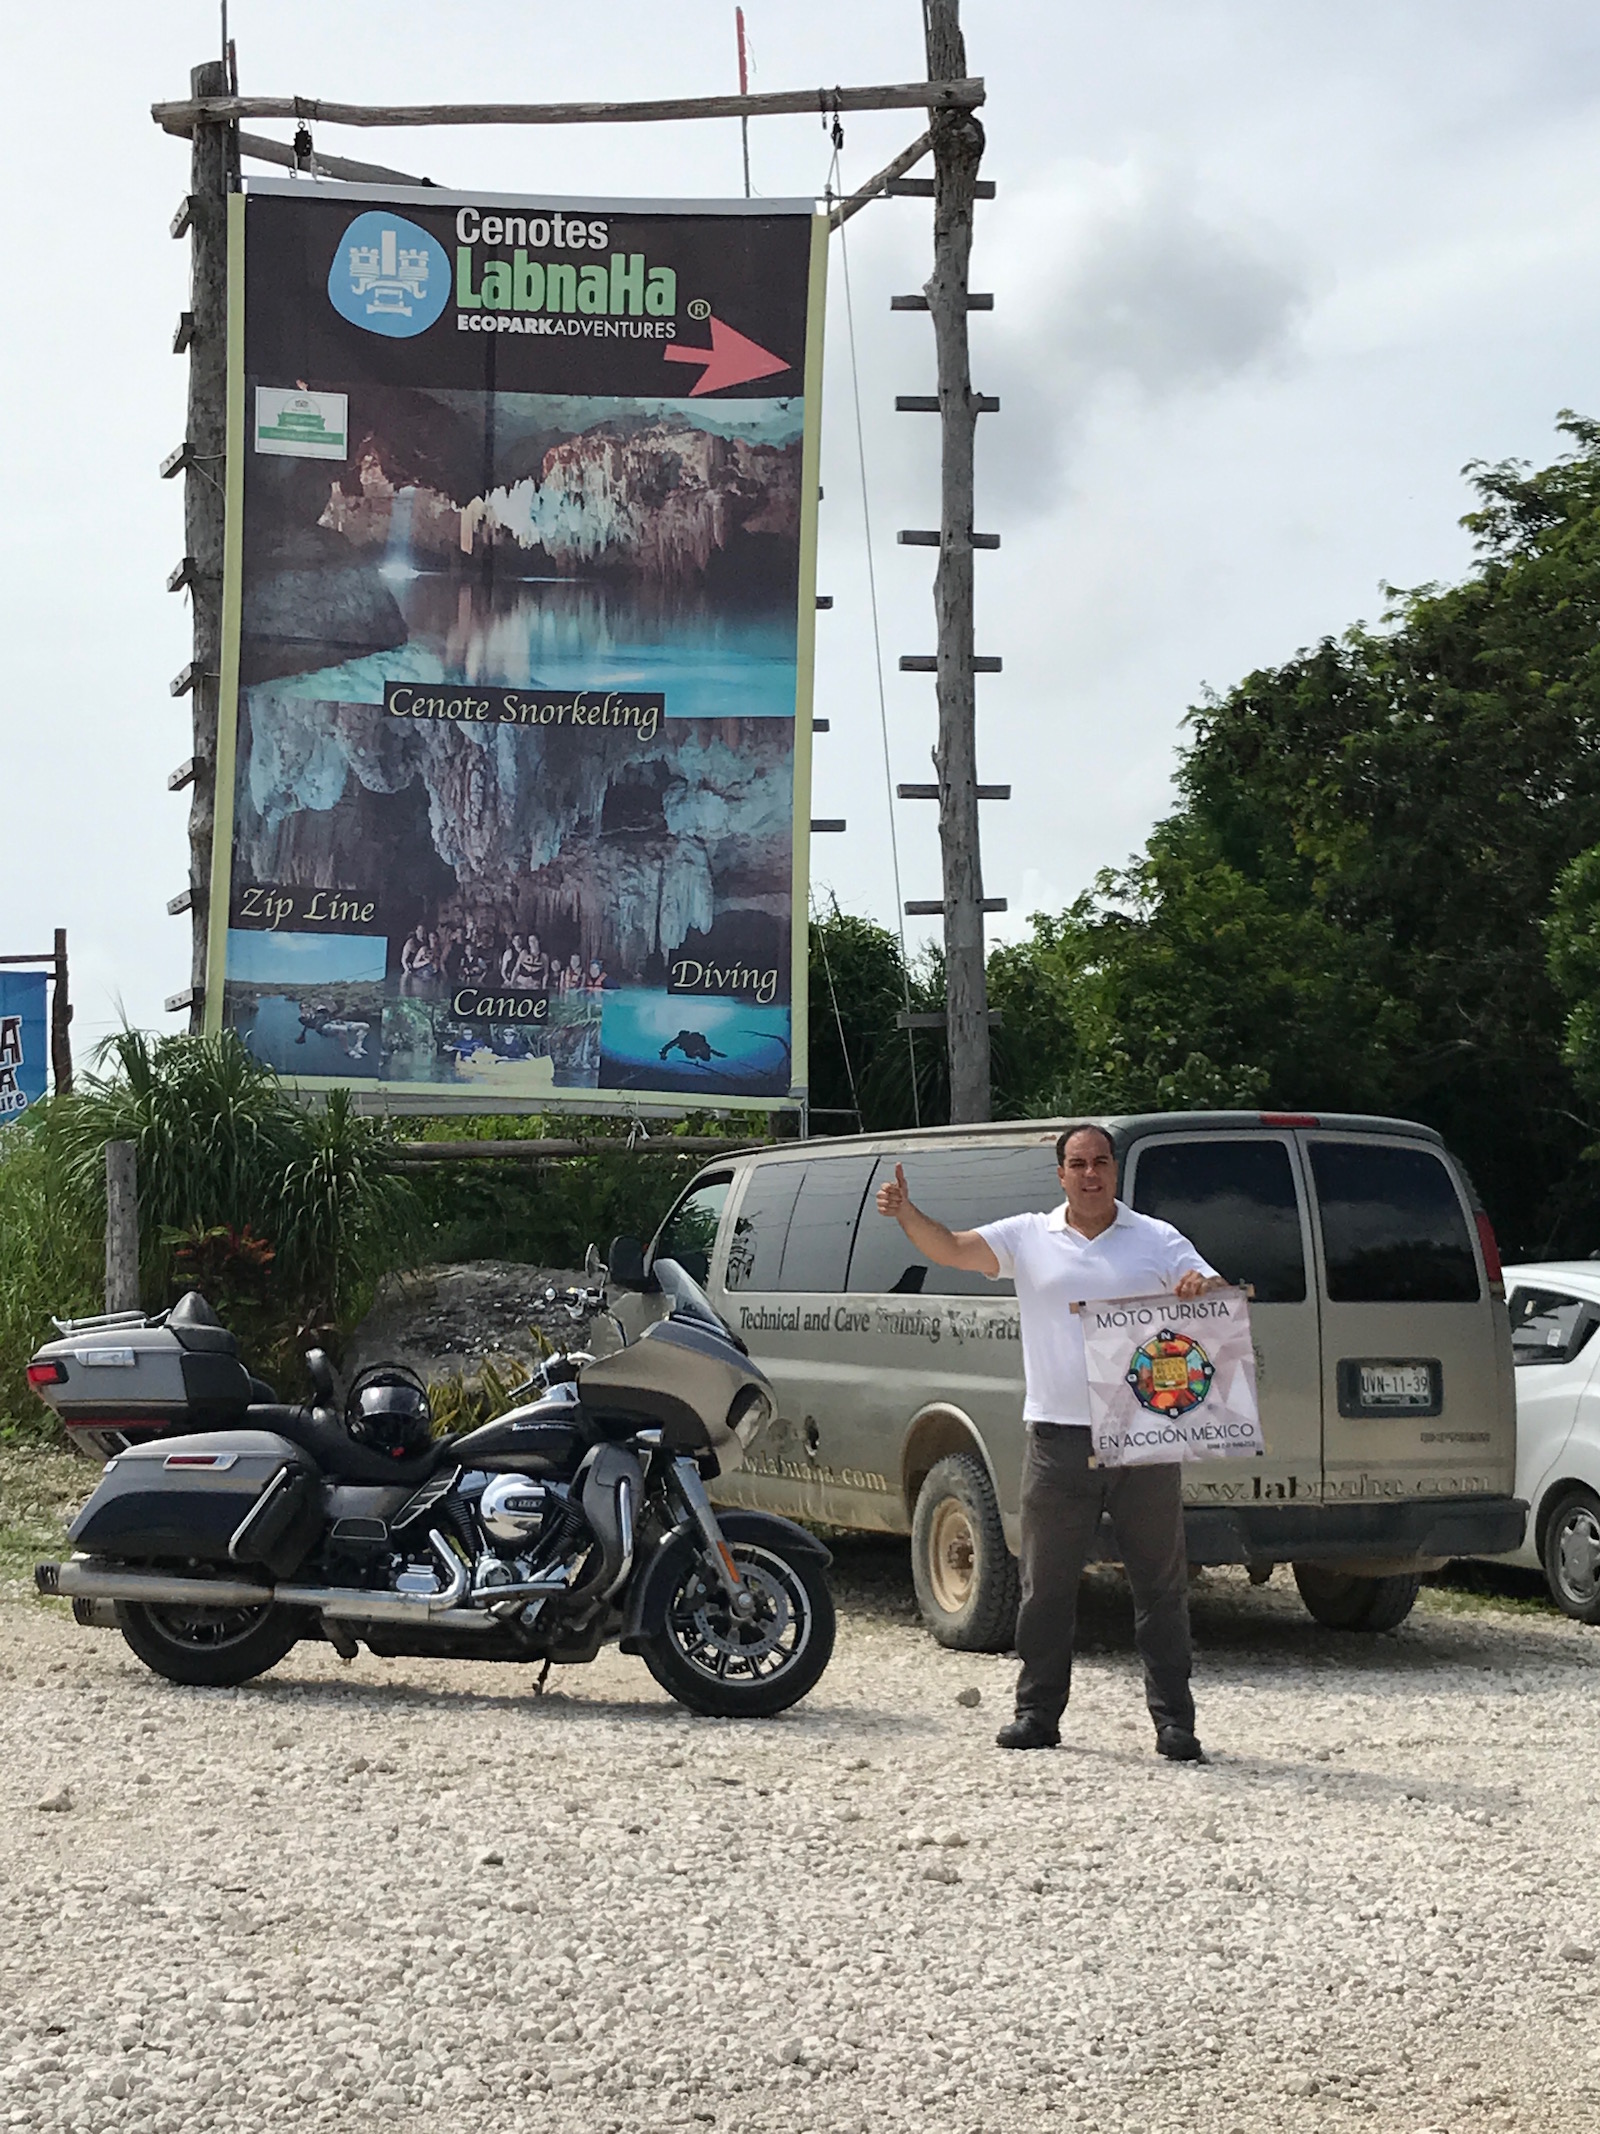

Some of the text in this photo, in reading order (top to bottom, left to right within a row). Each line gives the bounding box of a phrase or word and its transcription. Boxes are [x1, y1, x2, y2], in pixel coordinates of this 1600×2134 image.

[456, 207, 609, 250] Cenotes
[456, 246, 677, 317] LabnaHa
[389, 688, 659, 741] Cenote Snorkeling
[240, 888, 375, 931] Zip Line
[671, 959, 778, 1003] Diving
[453, 988, 548, 1018] Canoe
[740, 1305, 800, 1331] Technical
[803, 1305, 831, 1331] and
[834, 1306, 870, 1332] Cave
[947, 1309, 1021, 1345] Xplorati
[1096, 1301, 1230, 1329] MOTO TURISTA
[1362, 1375, 1428, 1393] UVN-11-39
[1100, 1435, 1120, 1450] EN
[1123, 1425, 1188, 1448] ACCIÓN
[1191, 1423, 1254, 1442] MÉXICO
